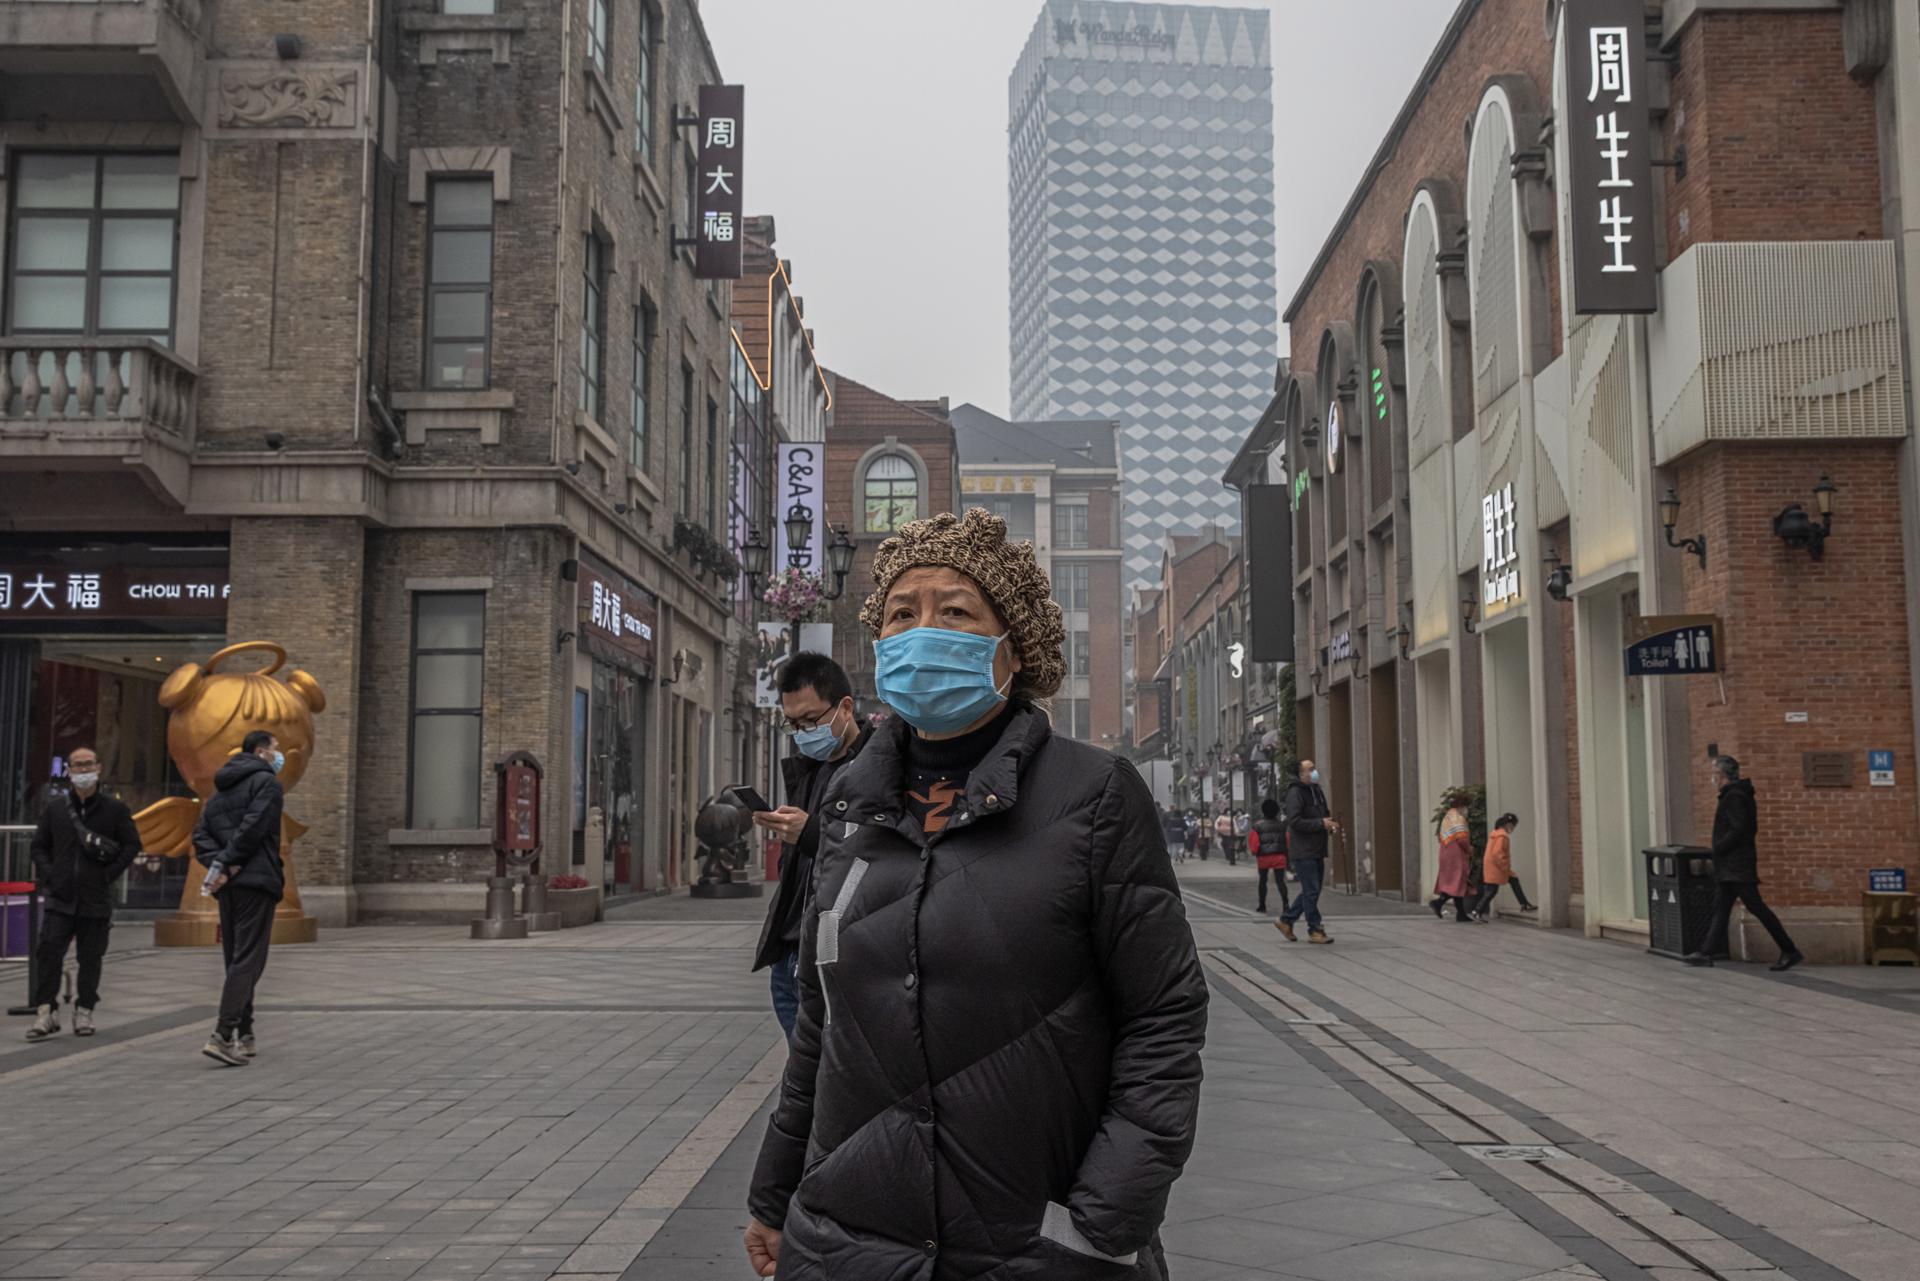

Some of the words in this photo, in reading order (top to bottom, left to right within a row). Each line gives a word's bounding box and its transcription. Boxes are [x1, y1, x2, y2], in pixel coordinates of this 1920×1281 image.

[704, 117, 736, 242] 周大福
[1587, 26, 1637, 272] 周生生
[788, 447, 814, 498] C&A
[1482, 482, 1517, 573] 周生生
[129, 584, 181, 598] CHOW
[187, 584, 215, 598] TAI
[592, 580, 621, 637] 周大福
